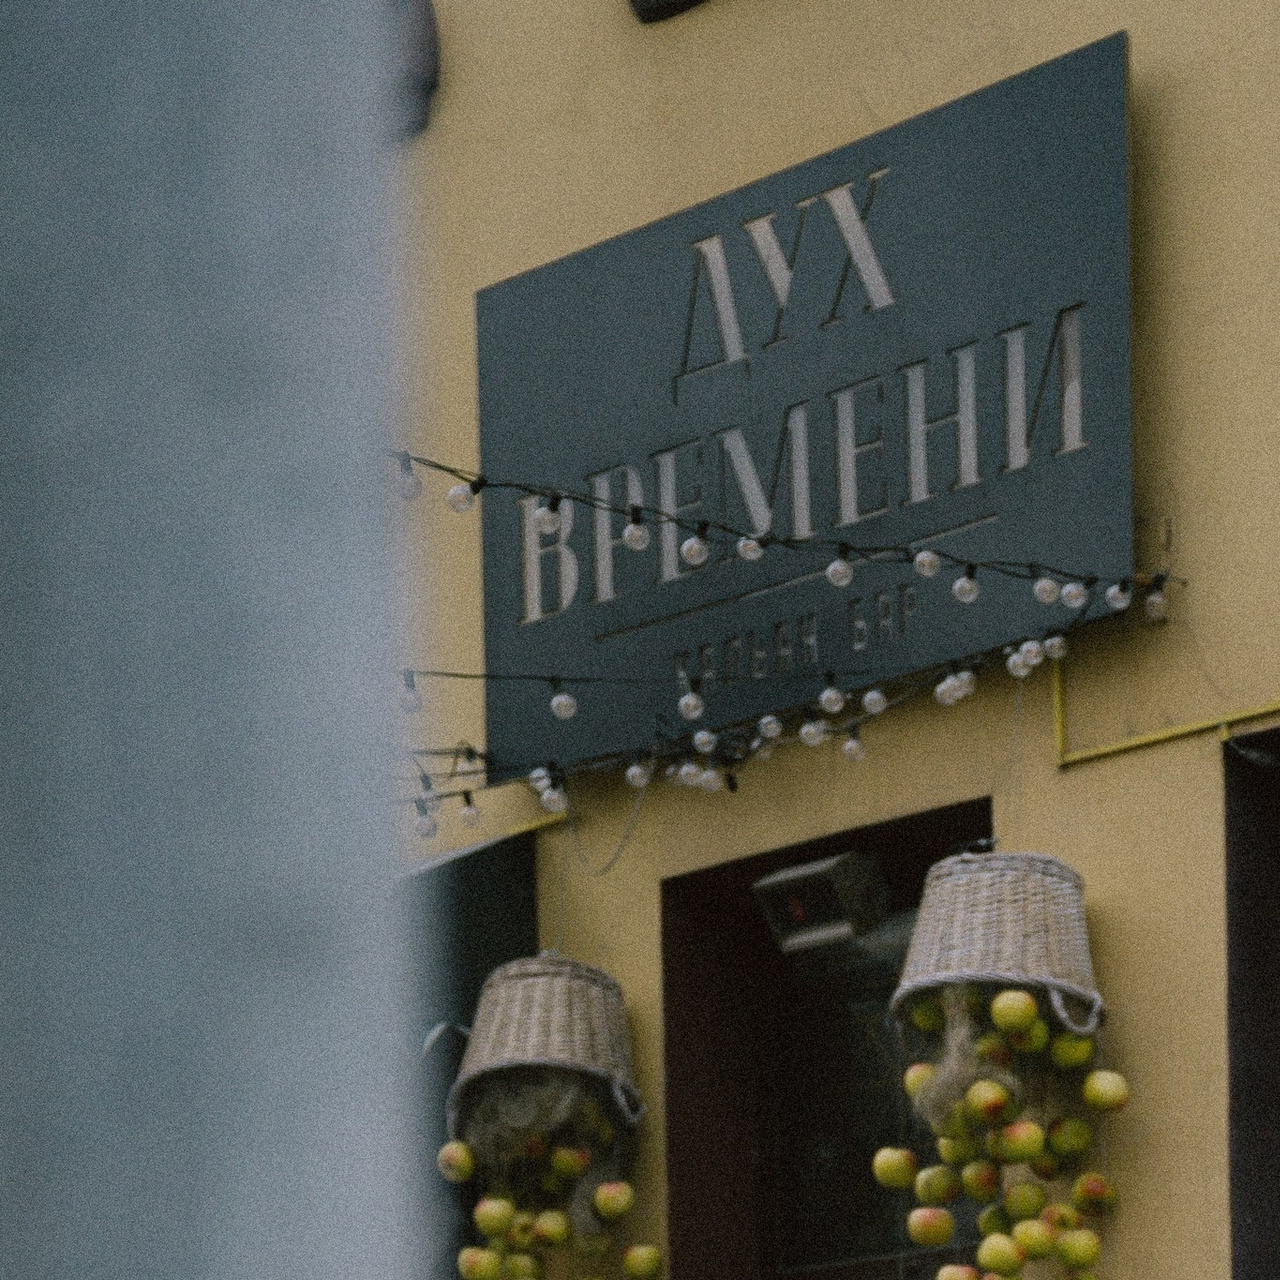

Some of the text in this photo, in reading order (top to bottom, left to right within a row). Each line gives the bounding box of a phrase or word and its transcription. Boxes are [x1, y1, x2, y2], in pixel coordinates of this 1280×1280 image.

[671, 166, 897, 405] ДУХ
[517, 301, 1090, 626] ВРЕМЕНИ
[849, 583, 916, 650] БАР
